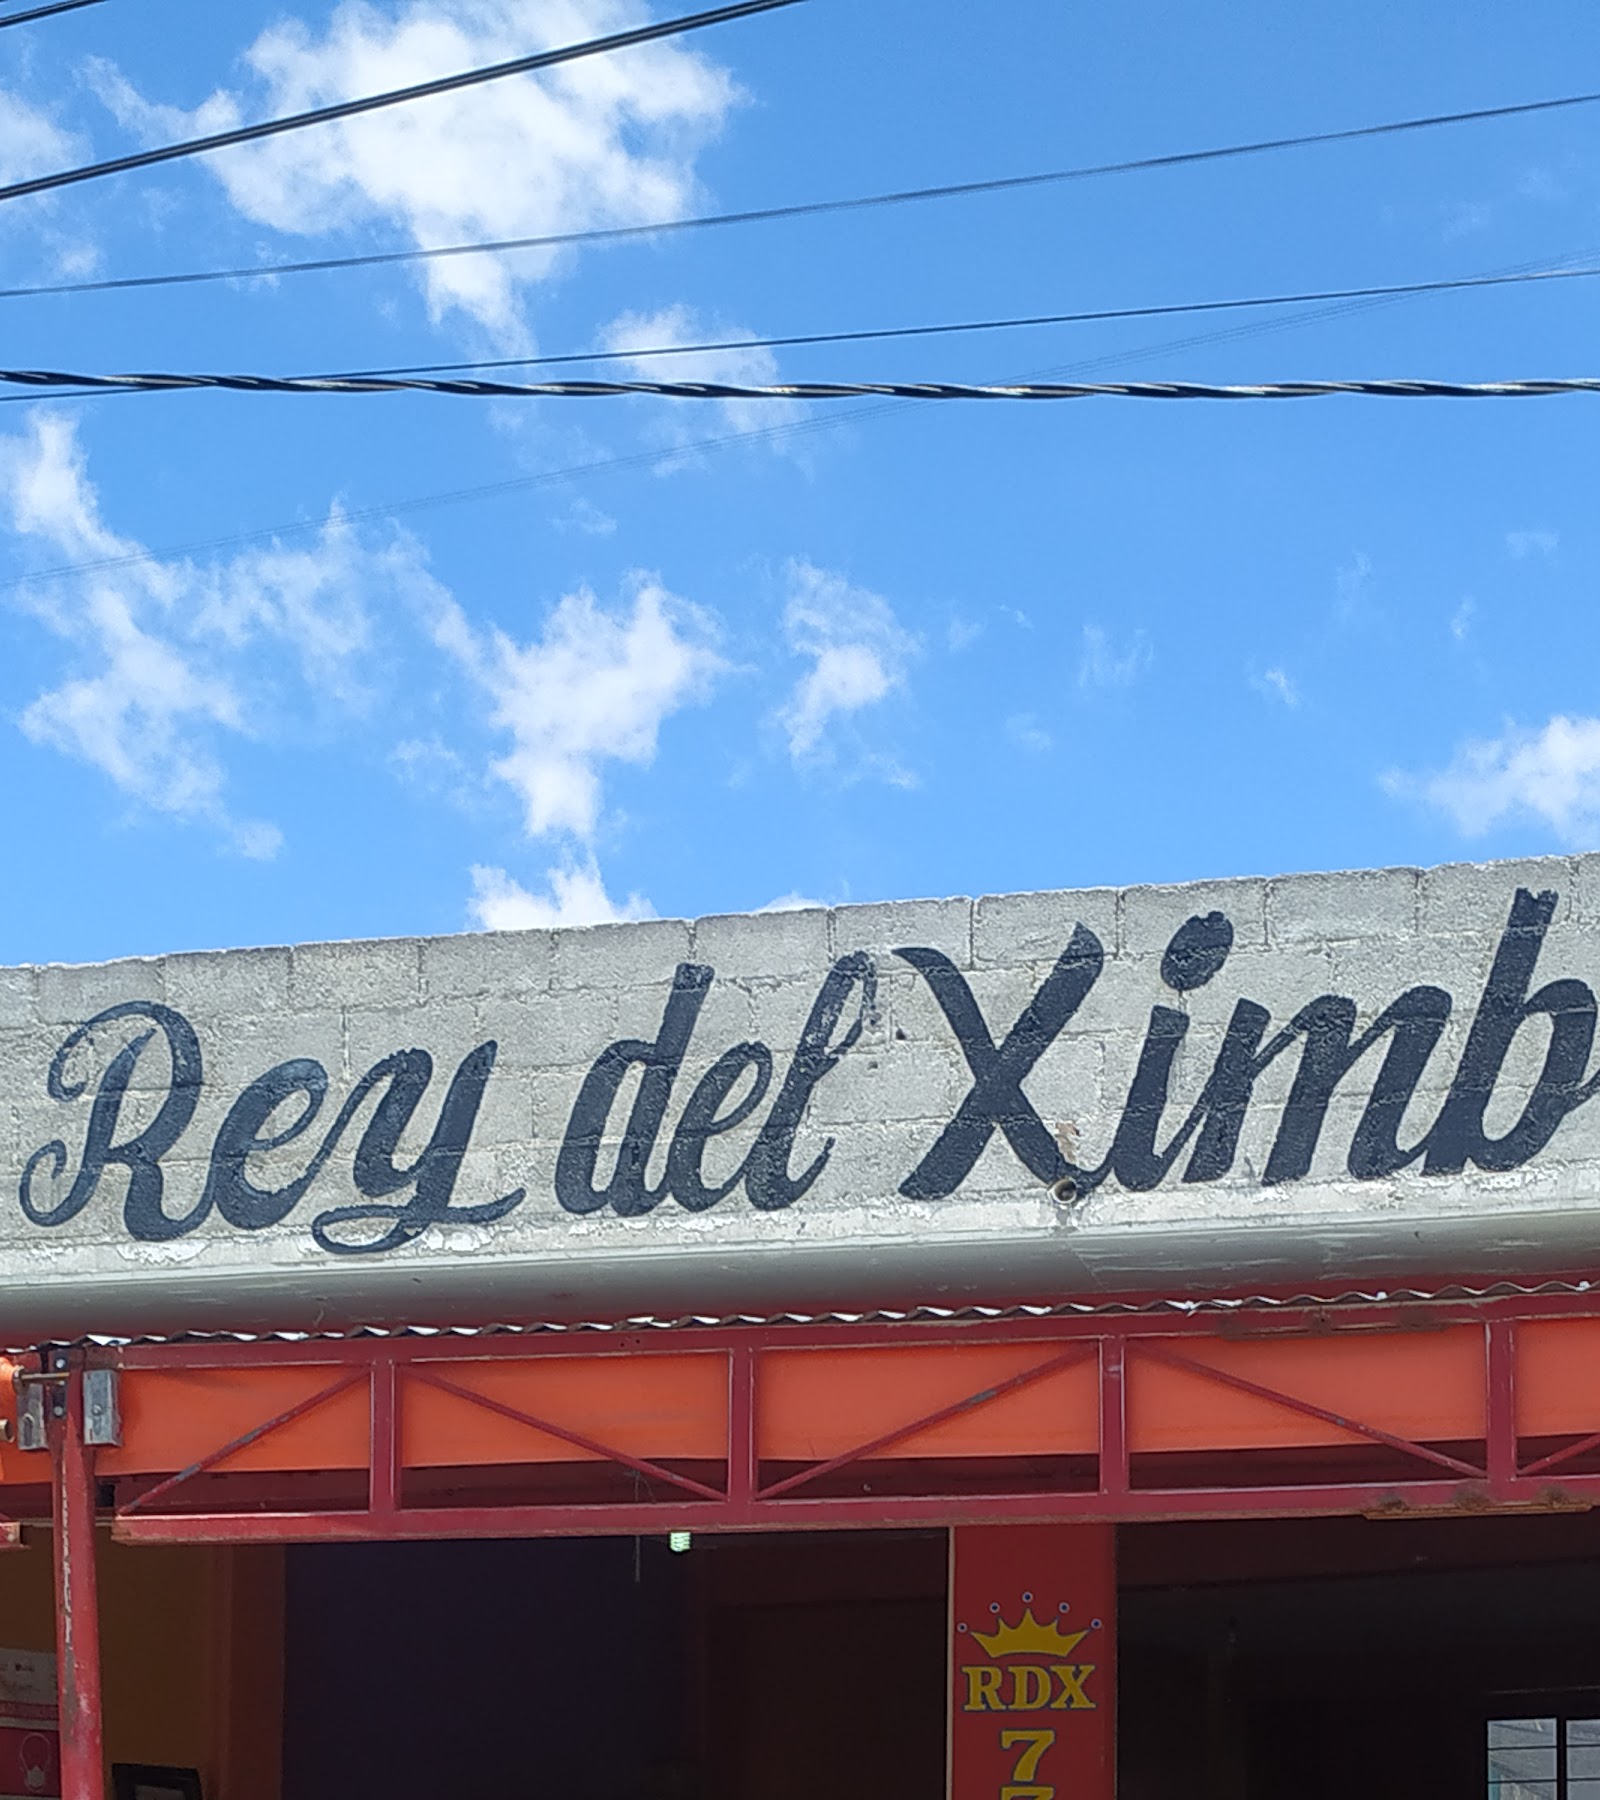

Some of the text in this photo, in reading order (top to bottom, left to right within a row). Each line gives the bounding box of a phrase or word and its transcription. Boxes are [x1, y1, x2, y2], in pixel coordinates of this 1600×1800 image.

[18, 1000, 525, 1254] Rey
[554, 949, 878, 1219] del
[961, 1663, 1097, 1712] RDX
